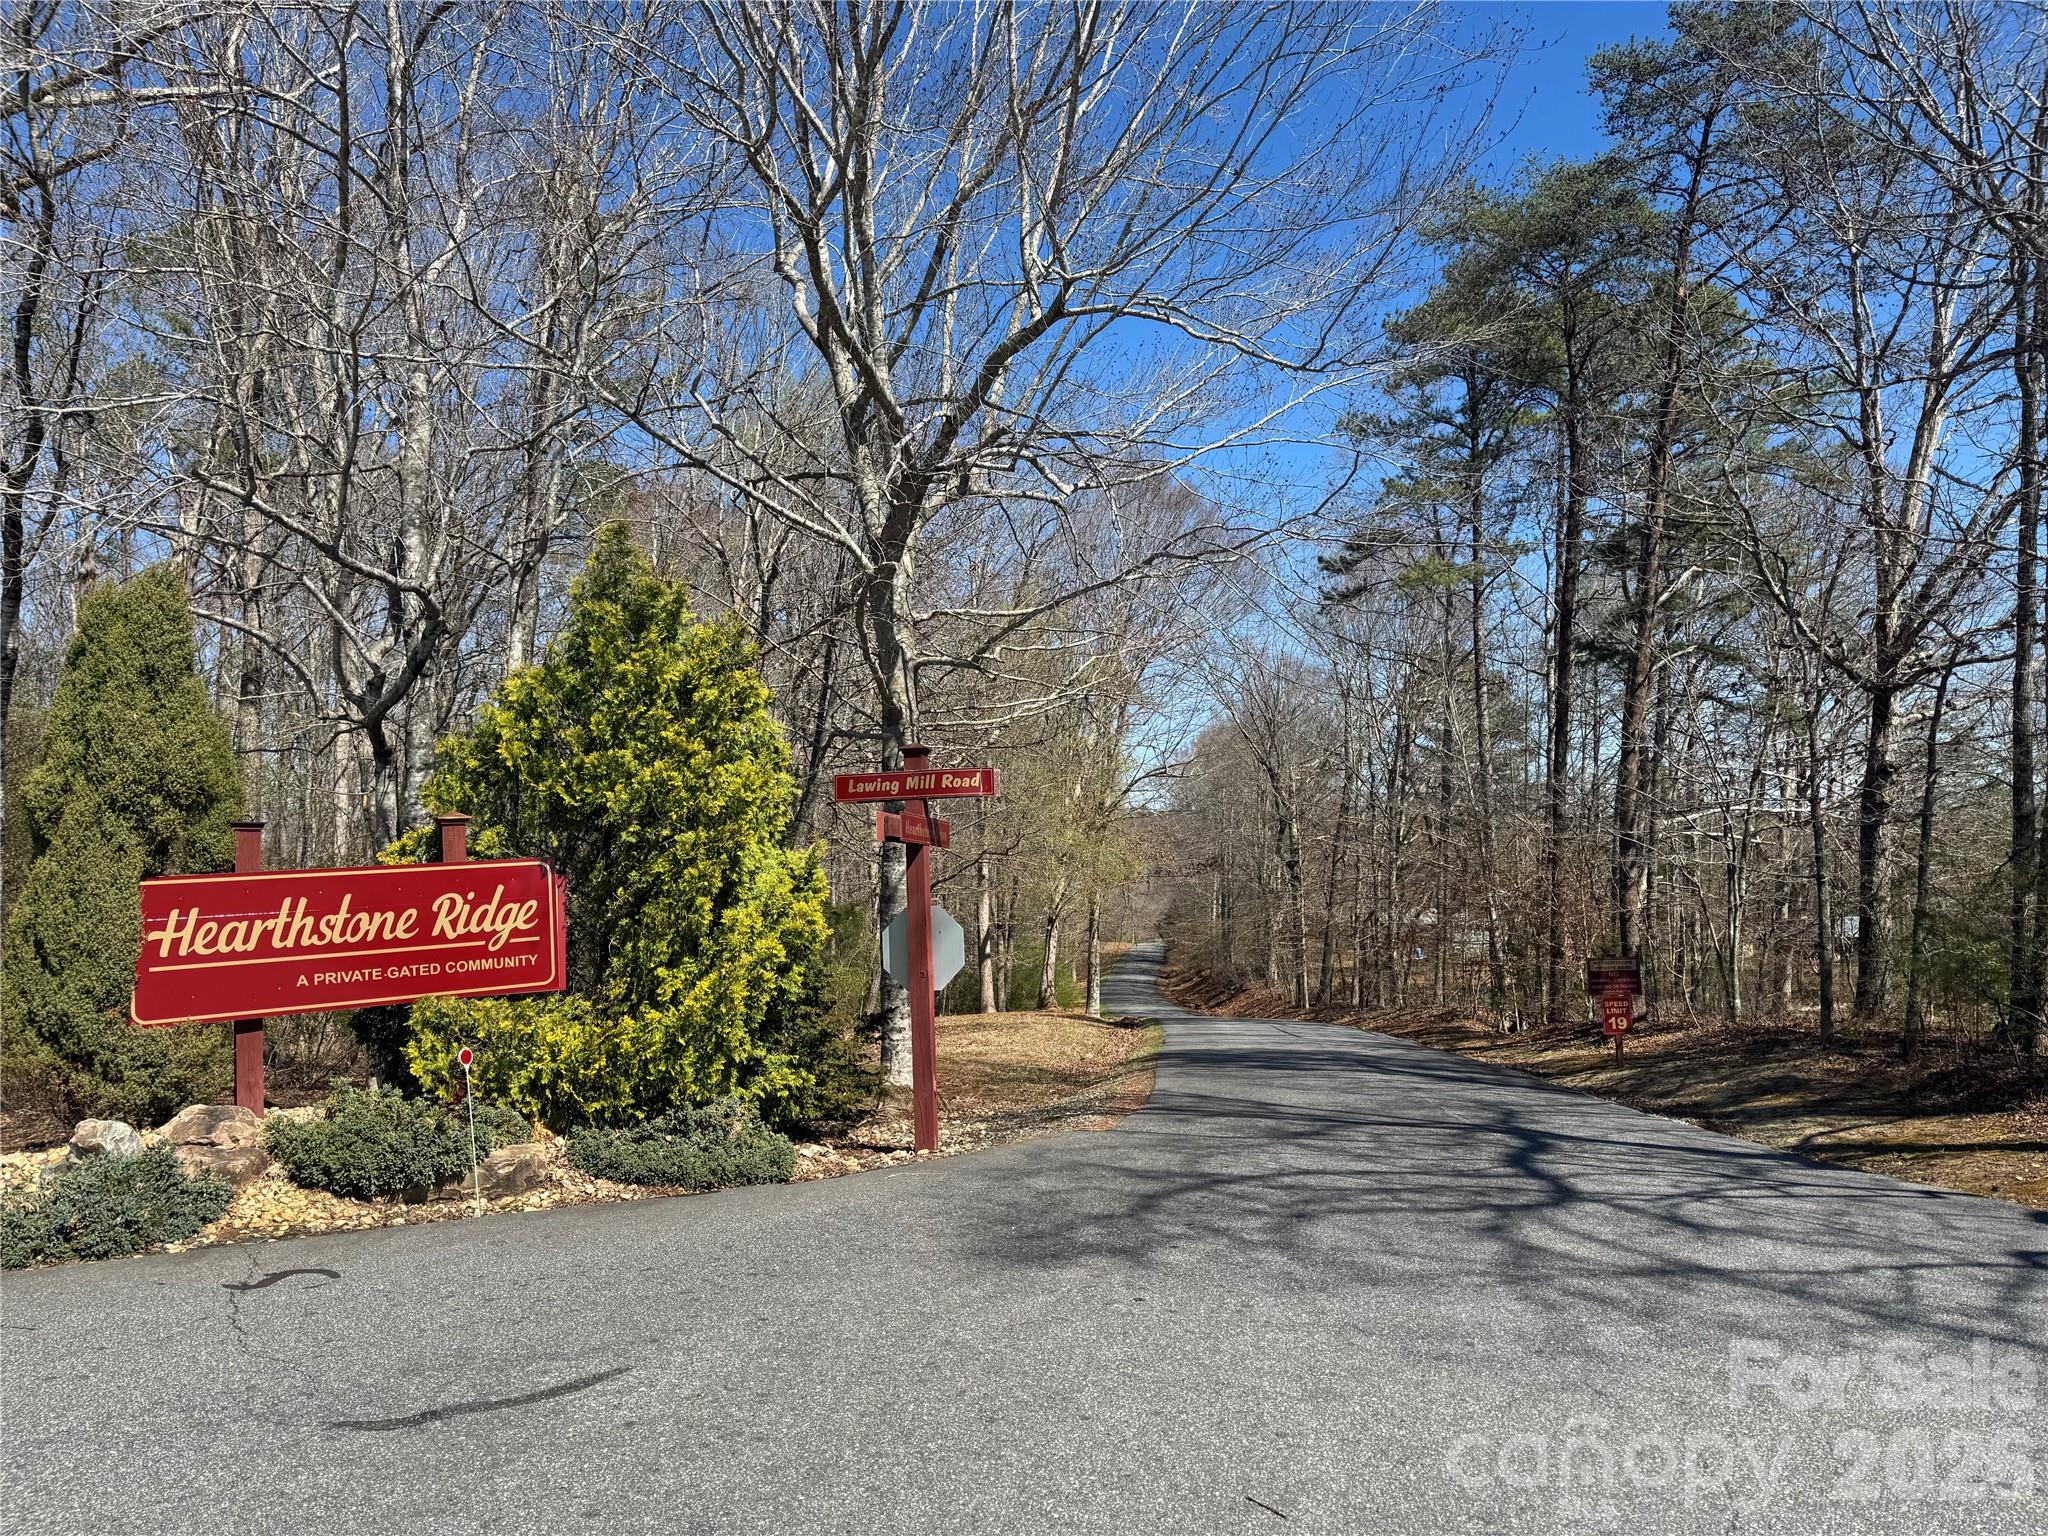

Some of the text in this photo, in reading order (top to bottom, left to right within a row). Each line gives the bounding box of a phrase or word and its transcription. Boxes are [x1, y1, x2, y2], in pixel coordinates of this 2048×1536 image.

[848, 772, 980, 795] Lawing Mill Road
[148, 884, 539, 958] Hearthstone Ridge
[296, 954, 538, 988] A PRIVATE GATED COMMUNITY
[1608, 1016, 1628, 1030] 19
